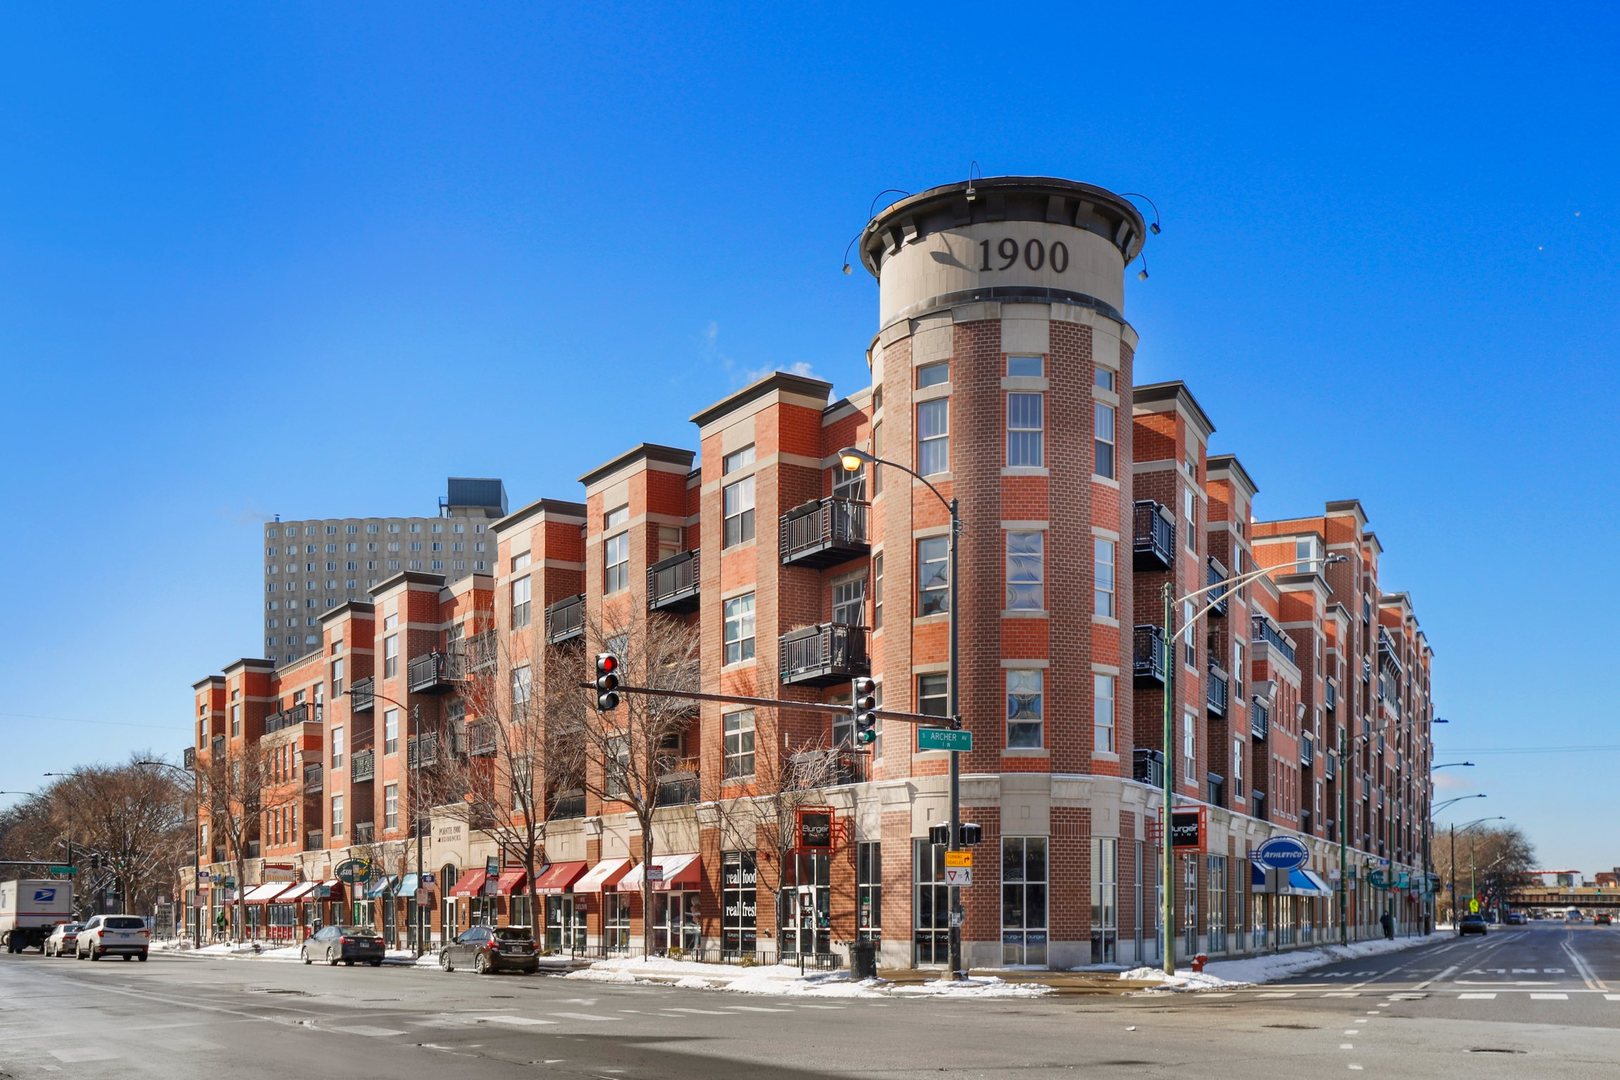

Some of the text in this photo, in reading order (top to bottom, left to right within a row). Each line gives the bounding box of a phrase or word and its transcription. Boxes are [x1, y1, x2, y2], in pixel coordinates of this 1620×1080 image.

[979, 238, 1069, 273] 1900
[930, 732, 957, 741] ARCHER
[802, 824, 829, 833] Burger
[726, 869, 756, 884] real food
[726, 902, 739, 916] real
